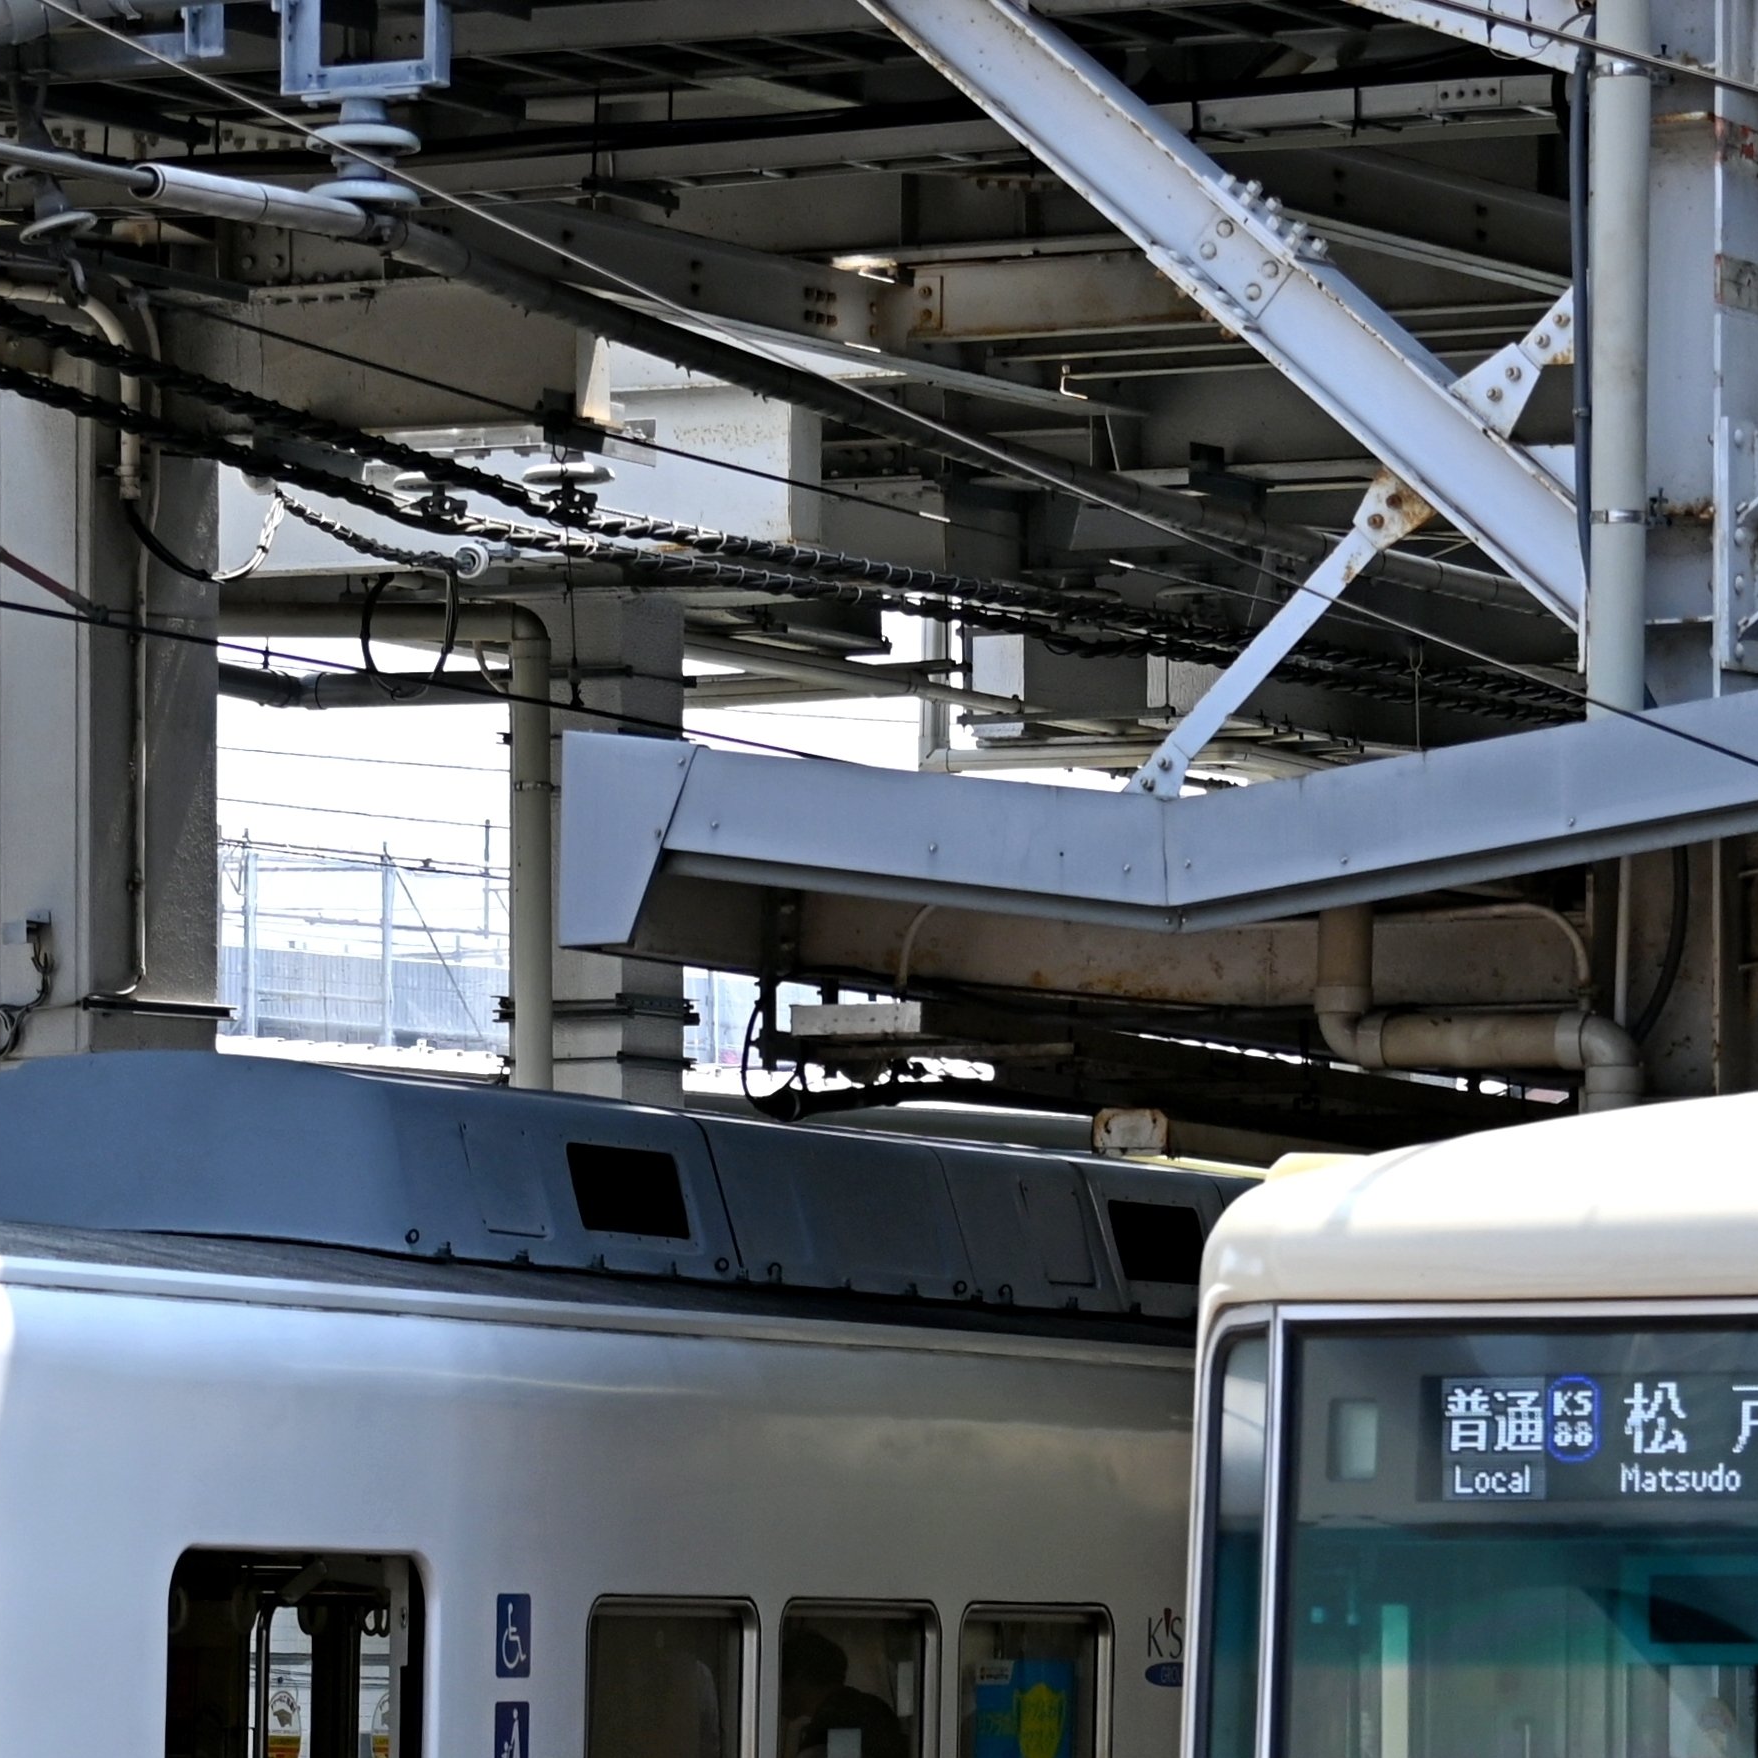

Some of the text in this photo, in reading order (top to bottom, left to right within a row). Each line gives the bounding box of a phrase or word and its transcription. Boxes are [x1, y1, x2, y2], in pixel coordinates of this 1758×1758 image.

[1553, 1390, 1593, 1417] KS
[1445, 1387, 1542, 1452] 普通
[1553, 1421, 1593, 1447] 88
[1454, 1462, 1742, 1494] Local Matsudo
